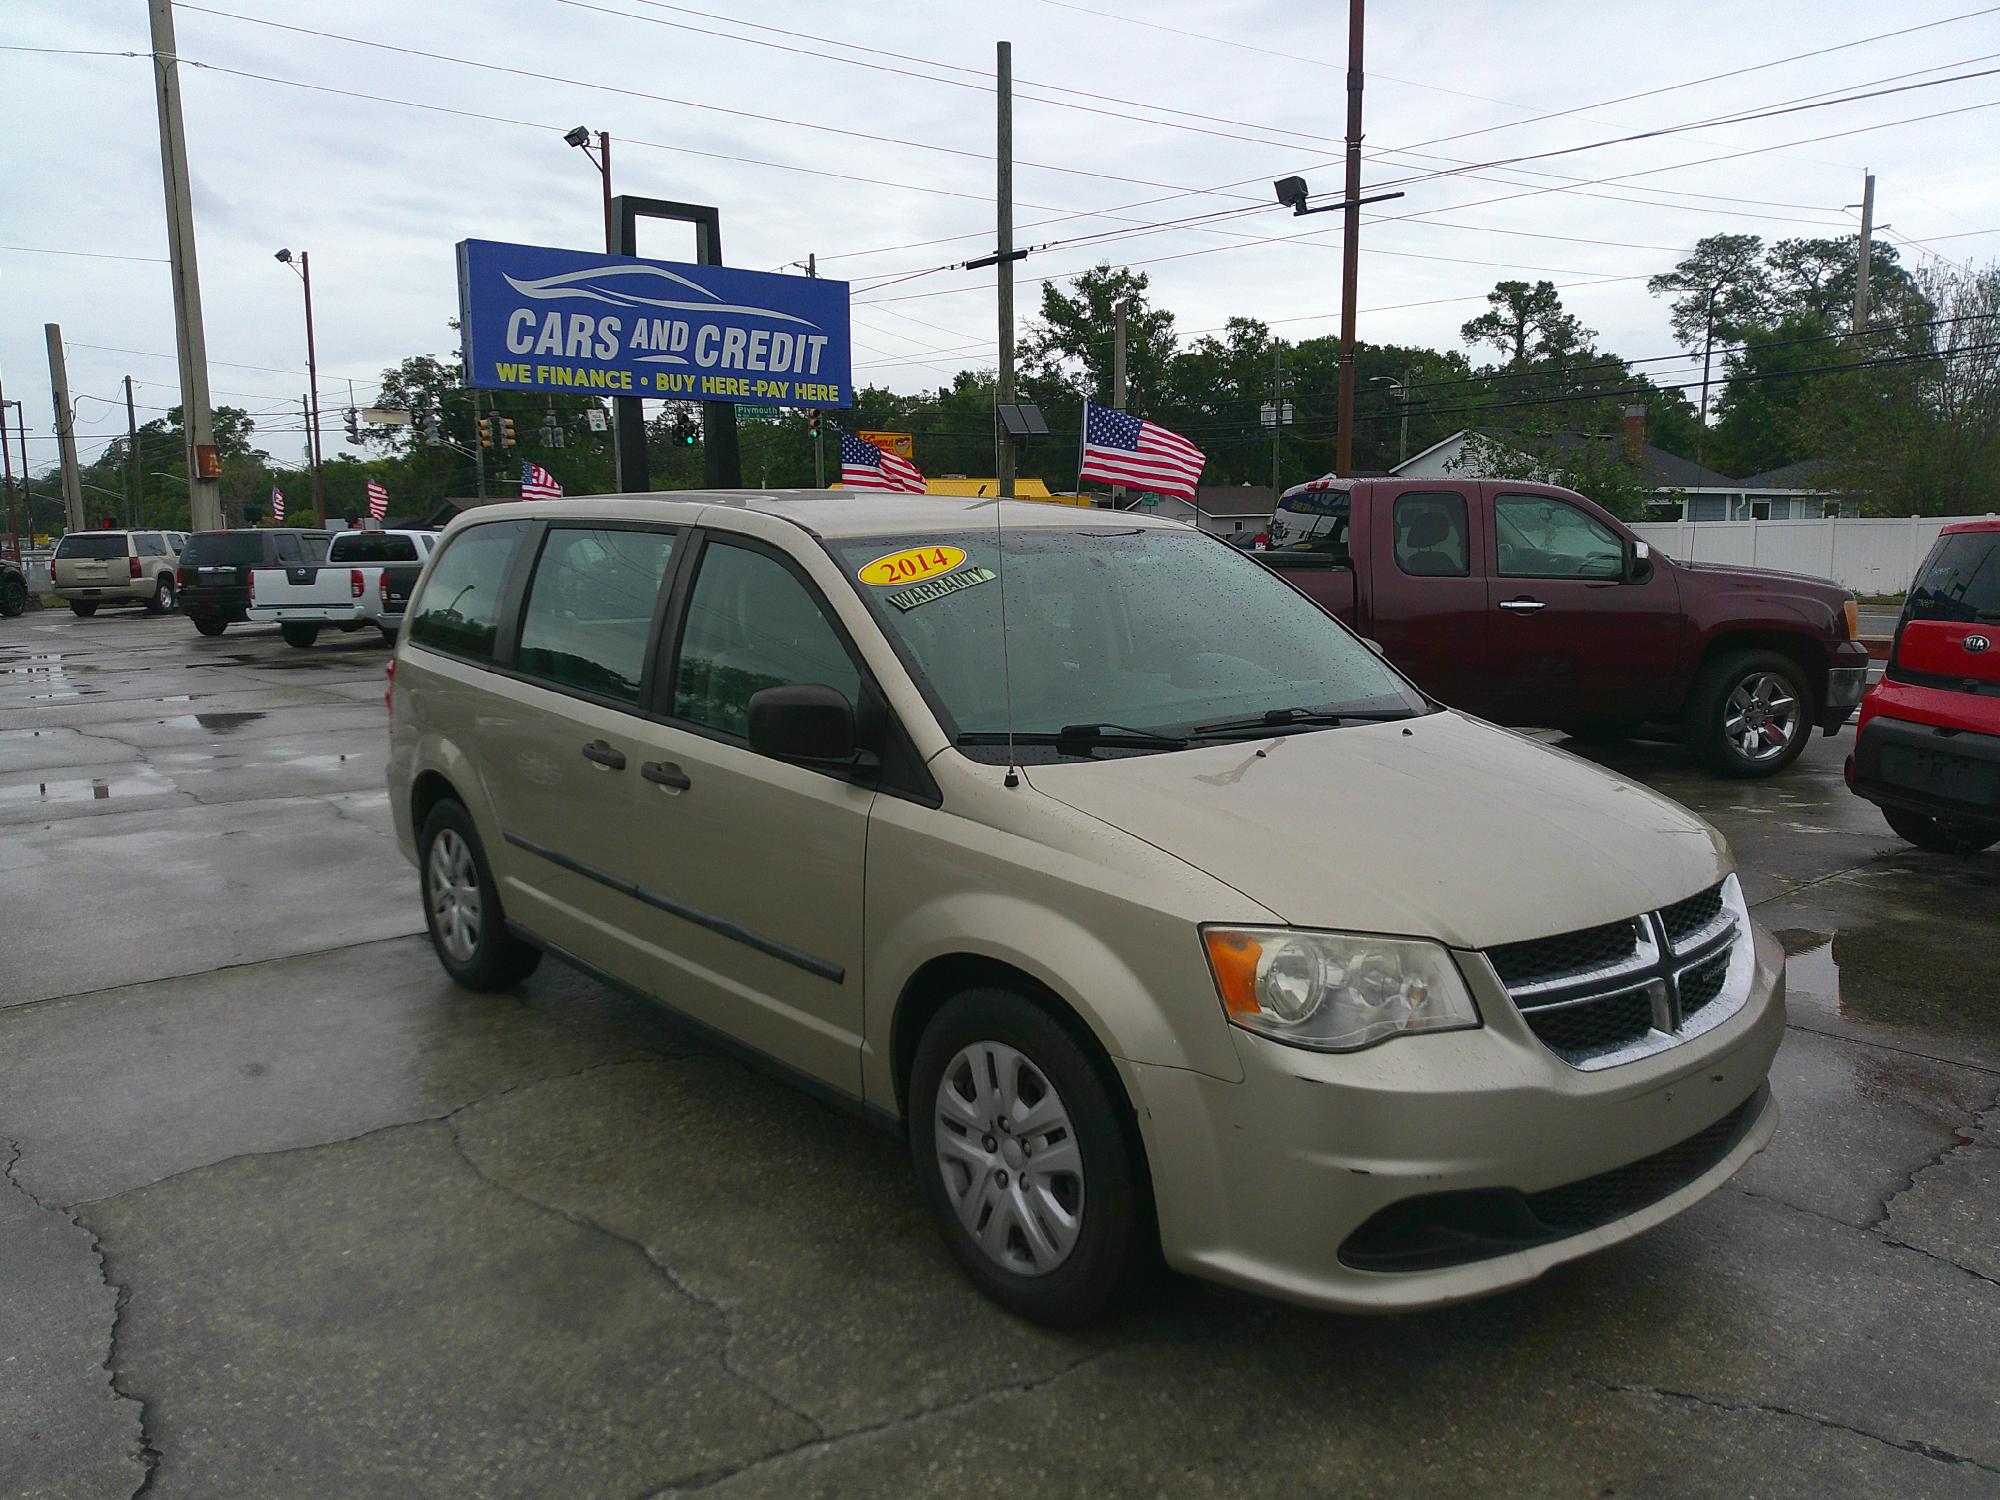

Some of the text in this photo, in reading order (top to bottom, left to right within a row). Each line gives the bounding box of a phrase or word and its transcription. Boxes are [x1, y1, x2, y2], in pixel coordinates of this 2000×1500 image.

[506, 308, 829, 375] CARS AND CREDIT
[495, 362, 532, 383] WE
[537, 365, 632, 390] FINANCE
[656, 372, 696, 393] BUY
[795, 383, 839, 402] HERE
[737, 406, 778, 415] Plymouth
[880, 547, 949, 583] 2014
[888, 566, 986, 609] WARRANTY
[1966, 638, 1984, 650] KIA
